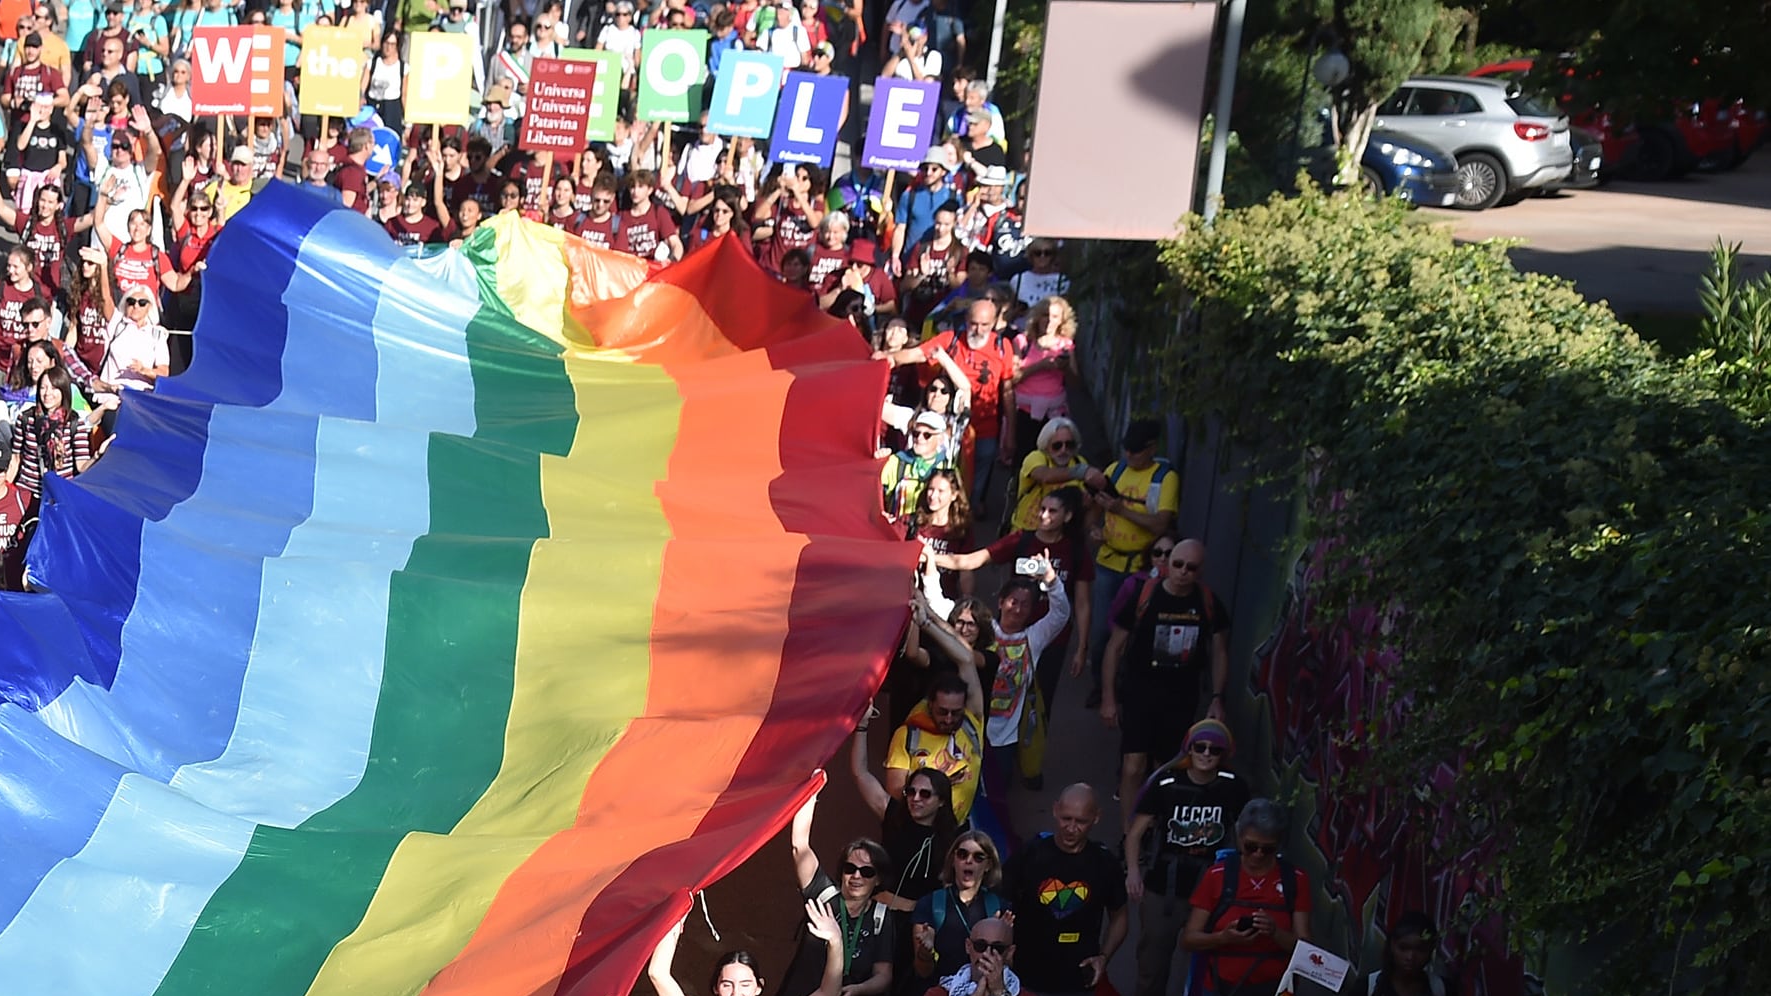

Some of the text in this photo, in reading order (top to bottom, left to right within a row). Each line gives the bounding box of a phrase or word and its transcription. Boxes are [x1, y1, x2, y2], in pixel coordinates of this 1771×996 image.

[307, 45, 358, 79] the
[419, 41, 464, 99] P
[645, 37, 700, 97] O
[725, 61, 775, 116] P
[787, 81, 824, 144] L
[880, 87, 925, 149] E
[534, 81, 586, 99] Universa
[531, 97, 586, 115] Universis
[529, 113, 578, 131] Patavina
[526, 130, 575, 146] Libertas
